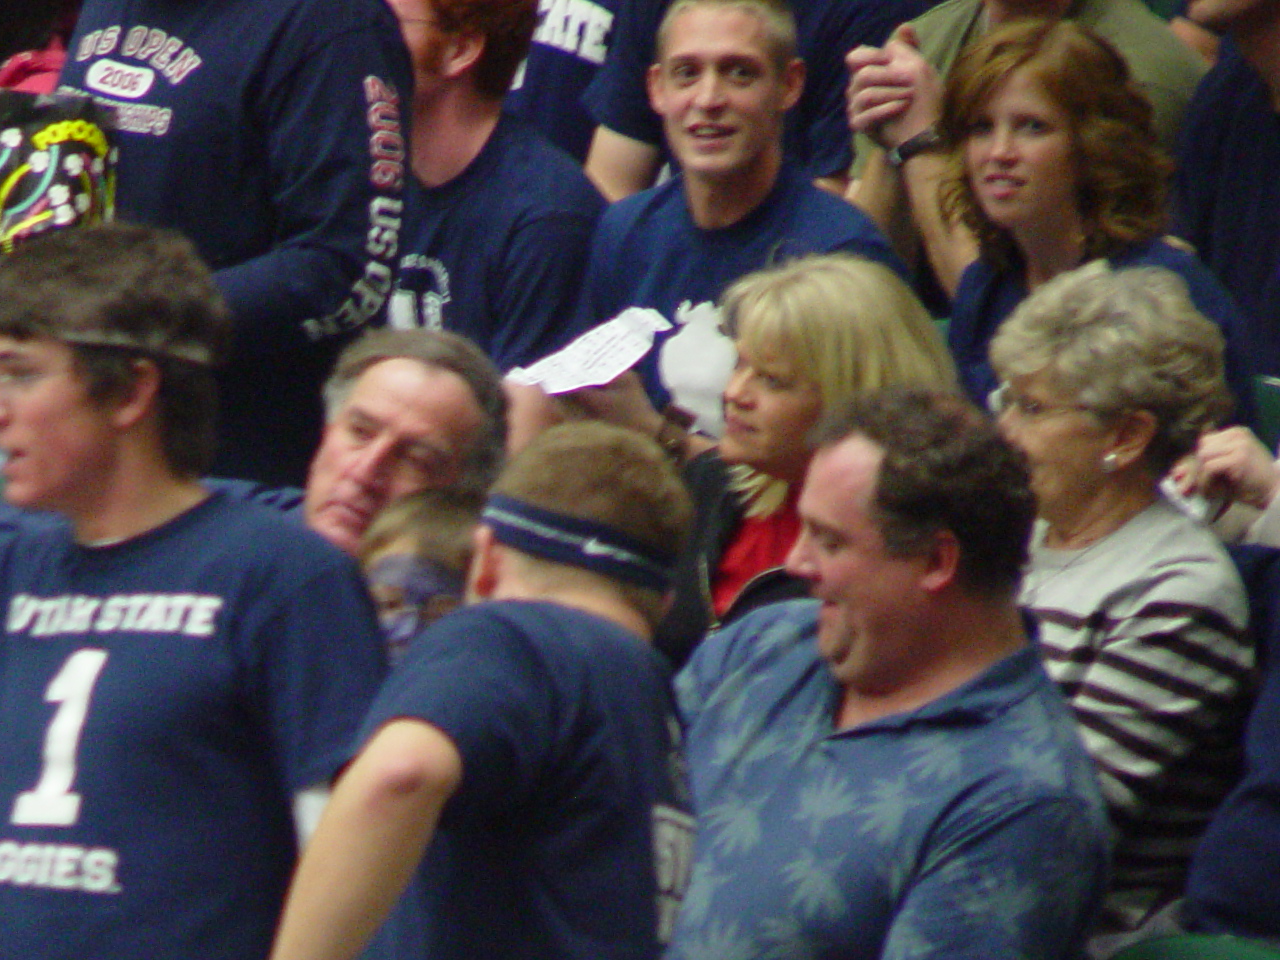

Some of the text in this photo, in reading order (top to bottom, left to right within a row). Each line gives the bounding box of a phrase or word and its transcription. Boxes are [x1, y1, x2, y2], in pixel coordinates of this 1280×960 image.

[76, 25, 202, 84] US OPEN
[97, 66, 144, 92] 2006
[363, 74, 405, 190] 2006
[365, 196, 404, 260] US
[7, 592, 223, 637] UTAH STATE
[10, 648, 109, 827] 1
